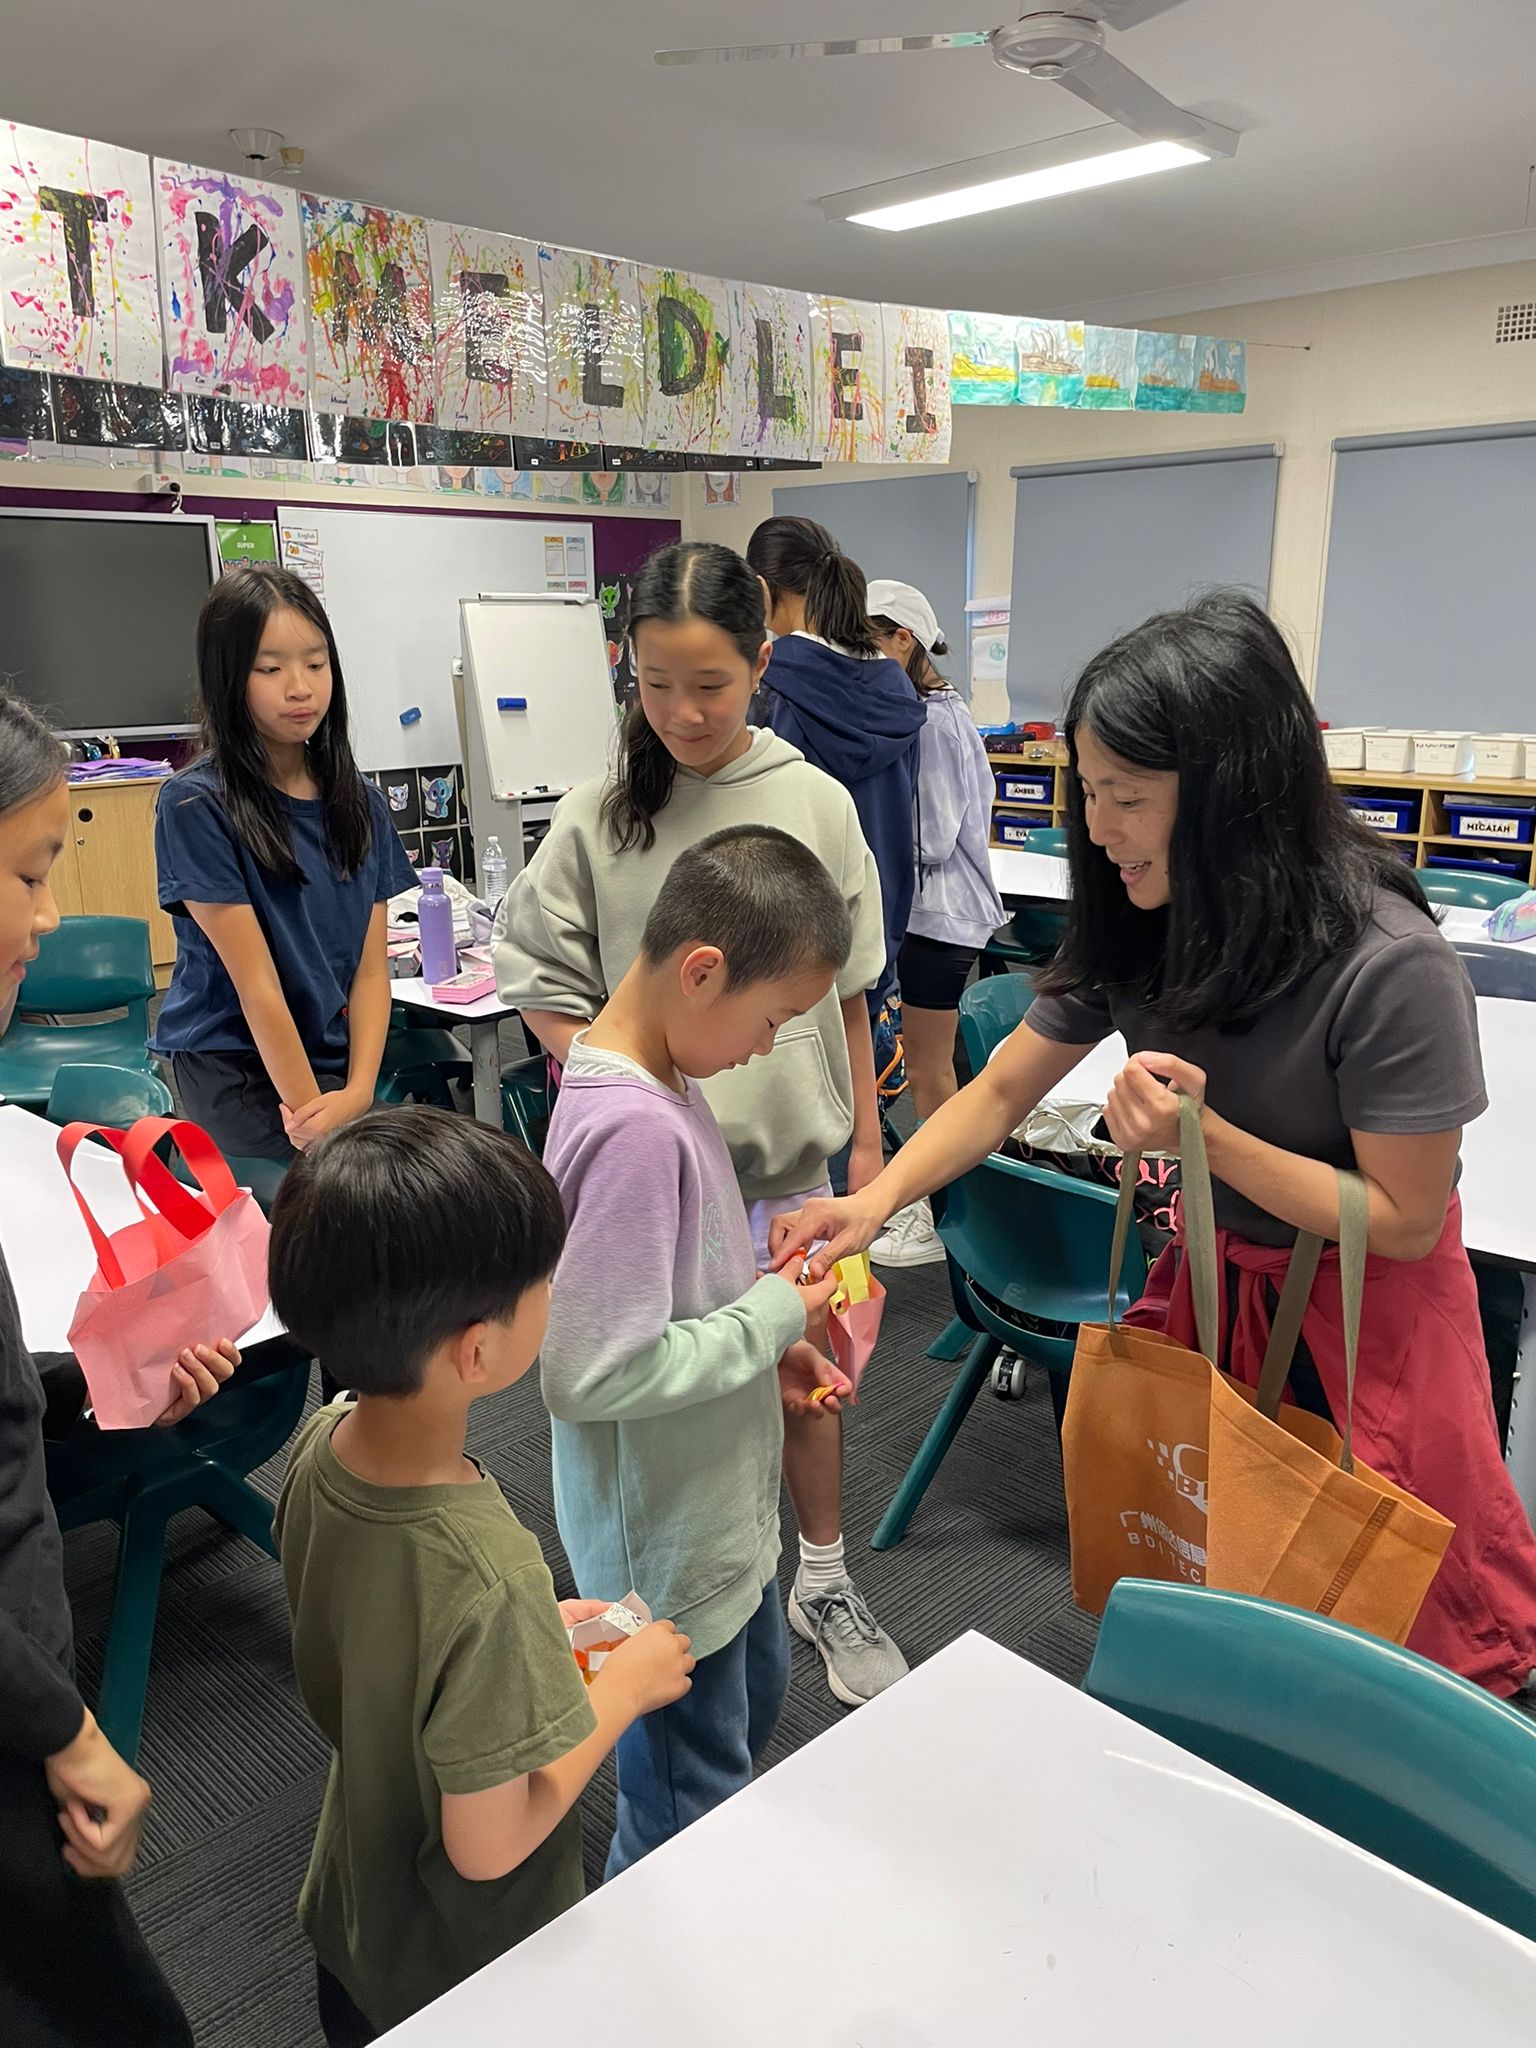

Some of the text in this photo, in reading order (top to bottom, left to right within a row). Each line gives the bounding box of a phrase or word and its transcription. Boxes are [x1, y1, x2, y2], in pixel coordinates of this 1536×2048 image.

[39, 185, 109, 318] T
[194, 211, 275, 344] K
[582, 302, 625, 408] L
[657, 297, 707, 396] D
[755, 318, 794, 421] L
[831, 332, 864, 421] E
[1014, 787, 1036, 795] AMBER
[1466, 822, 1511, 834] MICAIAH
